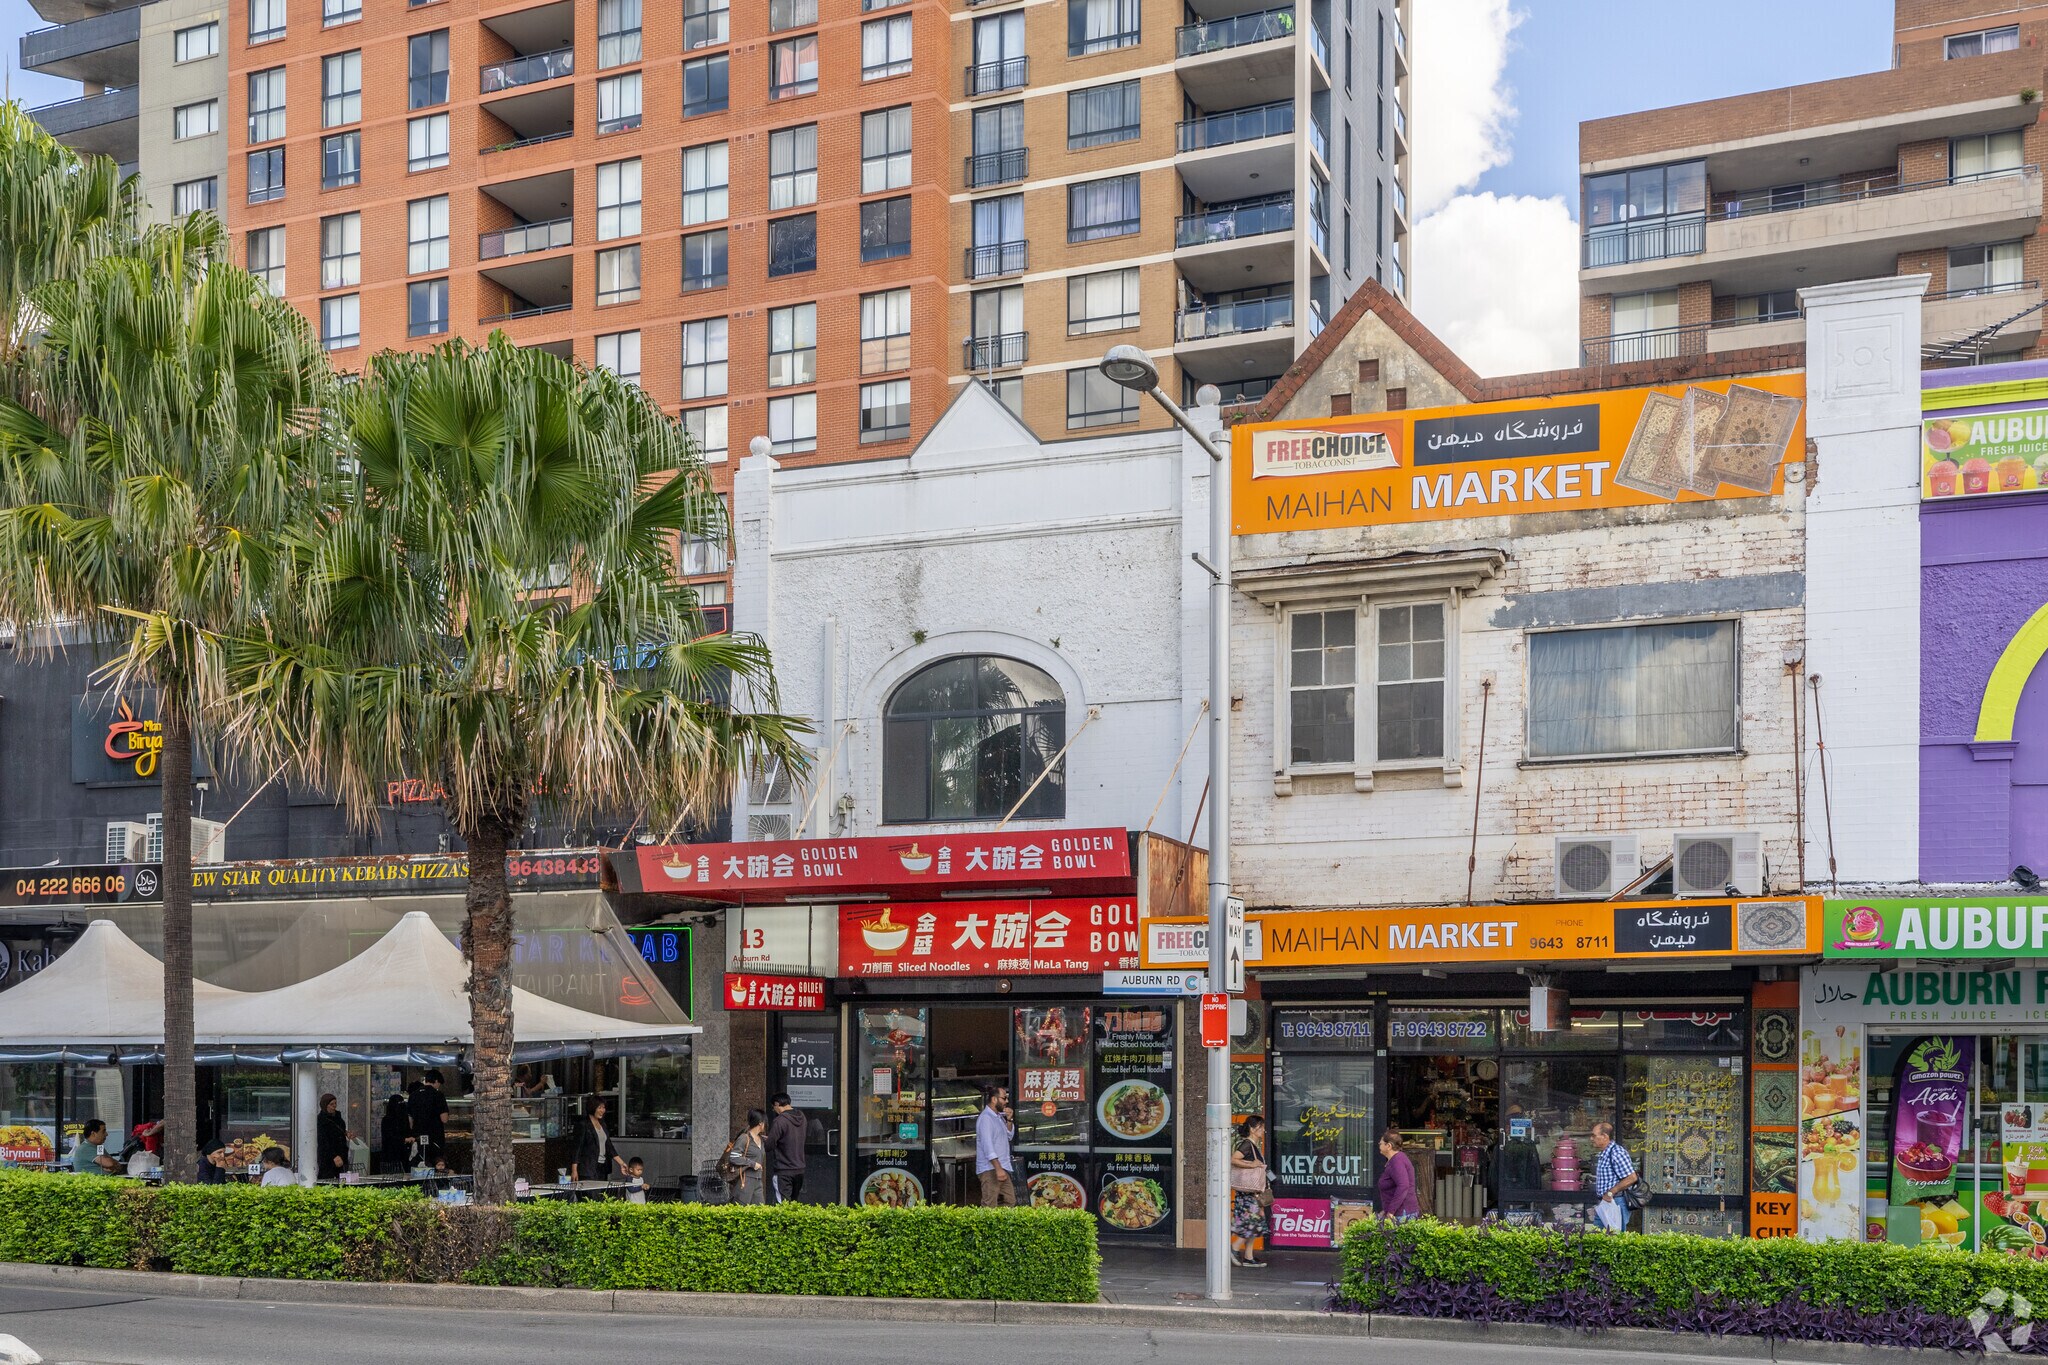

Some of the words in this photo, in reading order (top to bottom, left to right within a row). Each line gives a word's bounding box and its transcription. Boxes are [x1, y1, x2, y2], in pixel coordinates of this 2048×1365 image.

[1494, 418, 1584, 442] فروشگاه
[1969, 415, 2048, 446] AUBU
[1428, 430, 1484, 450] میهن
[1266, 434, 1387, 463] FREECHOICE
[1981, 445, 2015, 456] FRESH
[2019, 442, 2048, 454] JUICE
[1293, 458, 1357, 470] TOBACCONIST
[1267, 486, 1392, 521] MAIHAN
[1411, 461, 1611, 510] MARKET
[387, 778, 448, 805] PIZZA
[1051, 836, 1114, 852] GOLDEN
[800, 845, 858, 861] GOLDEN
[965, 844, 1045, 872] 大碗会
[508, 856, 600, 877] 96438433
[722, 853, 795, 880] 大碗会
[1052, 854, 1097, 870] BOWL
[191, 871, 218, 888] EW
[221, 870, 262, 887] STAR
[267, 867, 341, 886] QUALITY
[342, 864, 409, 882] KEBABS
[411, 862, 470, 880] PIZZA'S
[802, 863, 843, 878] BOWL
[16, 878, 35, 896] 04
[39, 878, 68, 895] 222
[72, 876, 101, 894] 666
[105, 875, 125, 893] 06
[1229, 905, 1241, 920] ONE
[1637, 910, 1710, 929] فروشگاه
[951, 910, 1071, 951] 大碗会
[1555, 919, 1584, 927] PHONE
[740, 928, 765, 949] 13
[912, 912, 938, 956] 金盛
[1228, 925, 1242, 940] WAY
[1272, 925, 1379, 953] MAIHAN
[1389, 921, 1518, 950] MARKET
[1529, 937, 1564, 949] 9643
[1576, 936, 1608, 948] 8711
[1649, 932, 1696, 949] میهن
[513, 935, 564, 963] TAR
[1179, 949, 1210, 957] TOBACC
[760, 953, 770, 962] Rd
[861, 961, 893, 974] 刀削面
[897, 960, 927, 973] Sliced
[929, 960, 971, 972] Noodles
[997, 958, 1030, 971] 麻辣烫
[1033, 959, 1061, 970] MaLa
[1064, 959, 1089, 971] Tang
[798, 981, 823, 994] GOLDEN
[1121, 975, 1163, 985] AUBURN
[1166, 975, 1181, 985] RD
[759, 982, 796, 1007] 大碗会
[1862, 971, 2021, 1006] AUBURN
[798, 995, 816, 1008] BOWL
[1203, 1003, 1227, 1011] STOPPING
[1890, 1010, 1939, 1020] FRESH
[1950, 1010, 1997, 1020] JUICE
[1112, 1033, 1135, 1041] Freshly
[790, 1054, 815, 1065] FOR
[790, 1067, 827, 1078] LEASE
[1119, 1065, 1131, 1073] Beef
[1131, 1065, 1145, 1073] Sliced
[1911, 1071, 1939, 1081] amazon
[1023, 1070, 1080, 1089] 麻辣烫
[1907, 1086, 1958, 1106] Açai
[0, 1146, 41, 1160] Birynani
[1038, 1152, 1065, 1161] 麻辣烫
[876, 1158, 894, 1166] Seafood
[894, 1158, 908, 1166] Laksa
[1051, 1161, 1064, 1171] Spicy
[1065, 1161, 1077, 1171] Soup
[1116, 1163, 1129, 1171] Fried
[1130, 1163, 1142, 1173] Spicy
[1281, 1155, 1318, 1174] KEY
[1321, 1155, 1362, 1175] CUT
[1281, 1174, 1313, 1185] WHILE
[1314, 1175, 1334, 1185] YOU
[1335, 1175, 1361, 1186] WAIT
[1906, 1177, 1951, 1190] Organic
[1756, 1202, 1791, 1216] KEY
[1756, 1227, 1792, 1240] CUT
